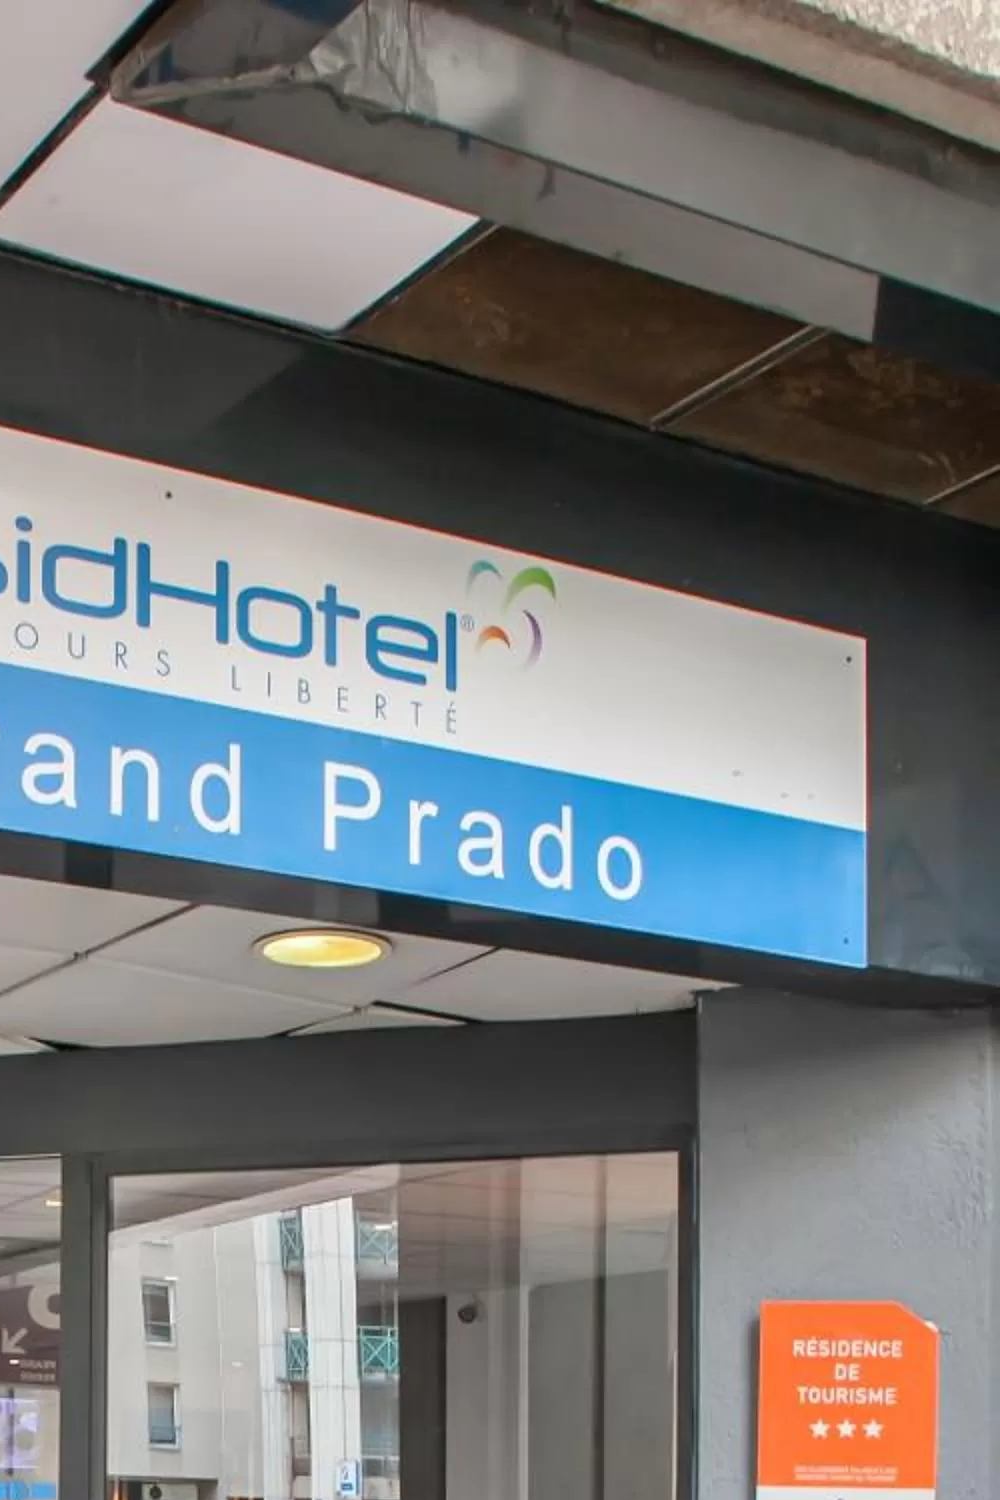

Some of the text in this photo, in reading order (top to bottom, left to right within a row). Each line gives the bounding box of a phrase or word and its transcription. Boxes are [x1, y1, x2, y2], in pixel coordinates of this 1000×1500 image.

[230, 664, 457, 734] LIBERTÉ
[322, 760, 643, 901] Prado
[792, 1337, 903, 1358] RÉSIDENCE
[834, 1363, 860, 1381] DE
[797, 1386, 898, 1406] TOURISME
